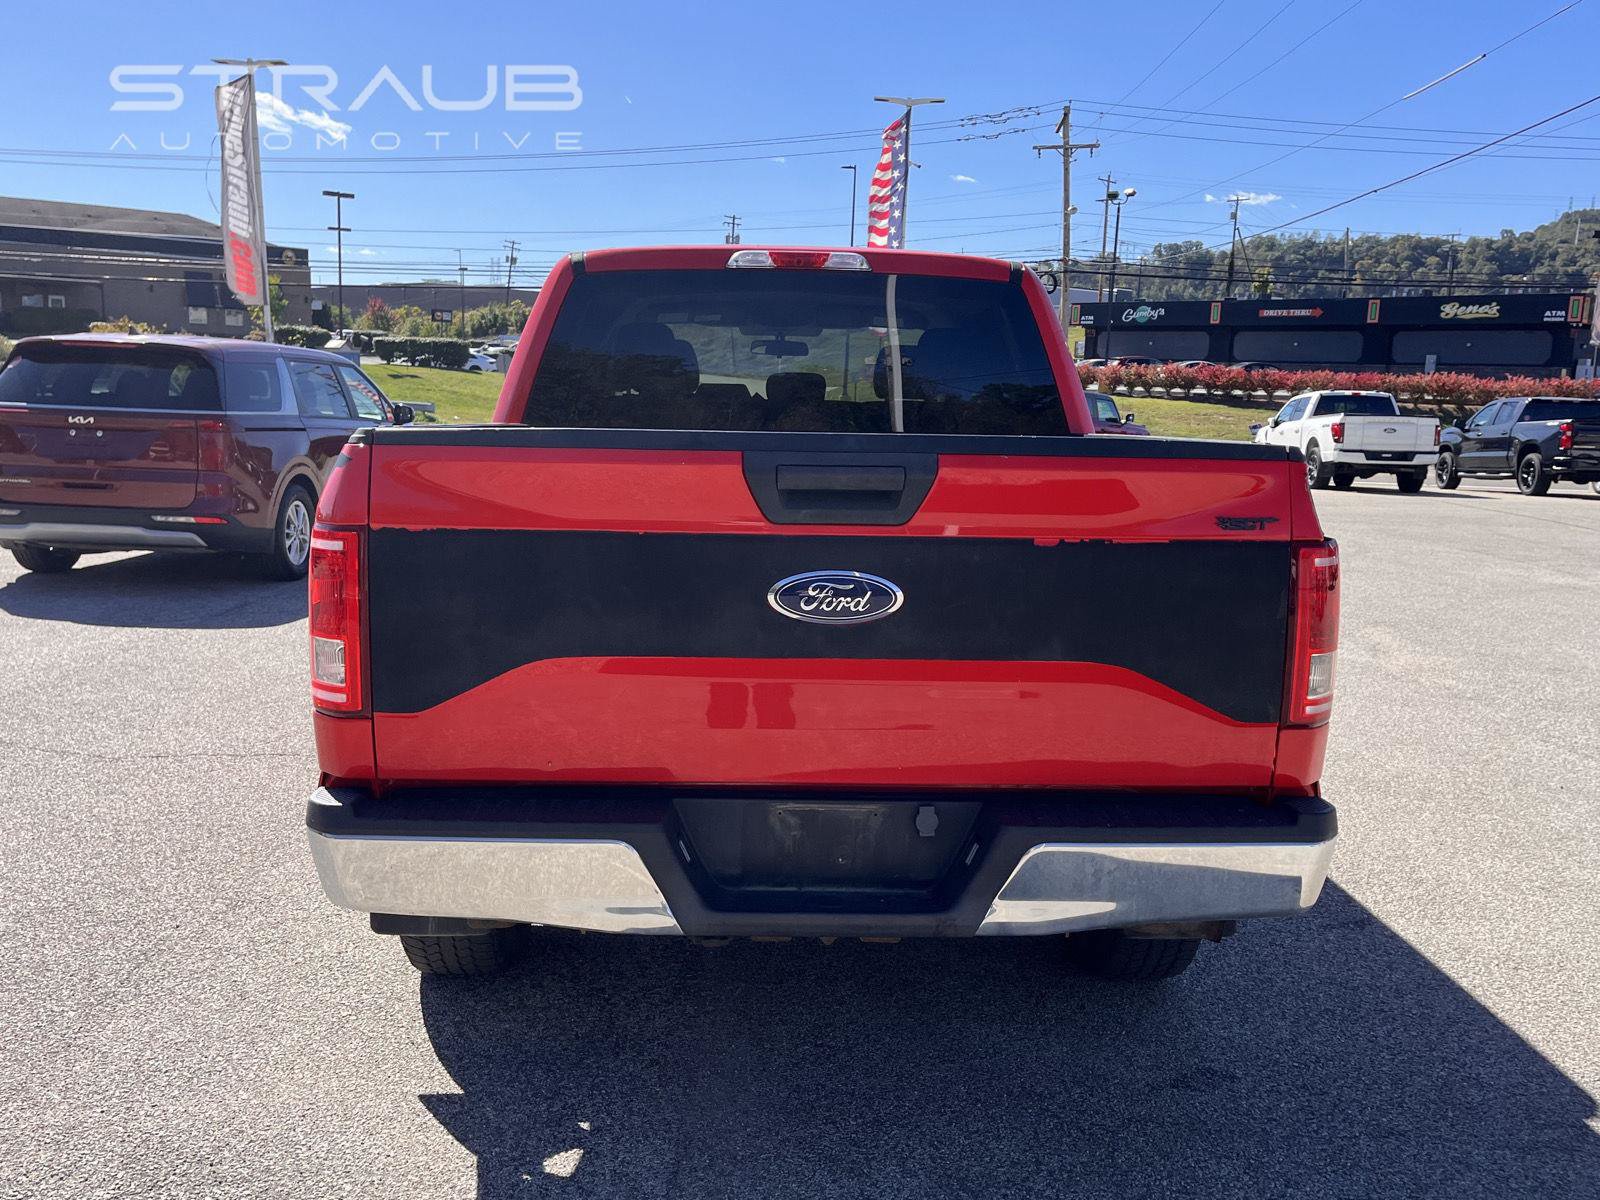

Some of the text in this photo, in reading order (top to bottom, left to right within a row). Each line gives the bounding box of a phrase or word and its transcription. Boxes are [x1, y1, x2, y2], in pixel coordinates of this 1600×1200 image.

[1122, 306, 1166, 322] Gumby's
[1263, 309, 1313, 317] DRIVE THRU
[800, 582, 873, 612] Ford
